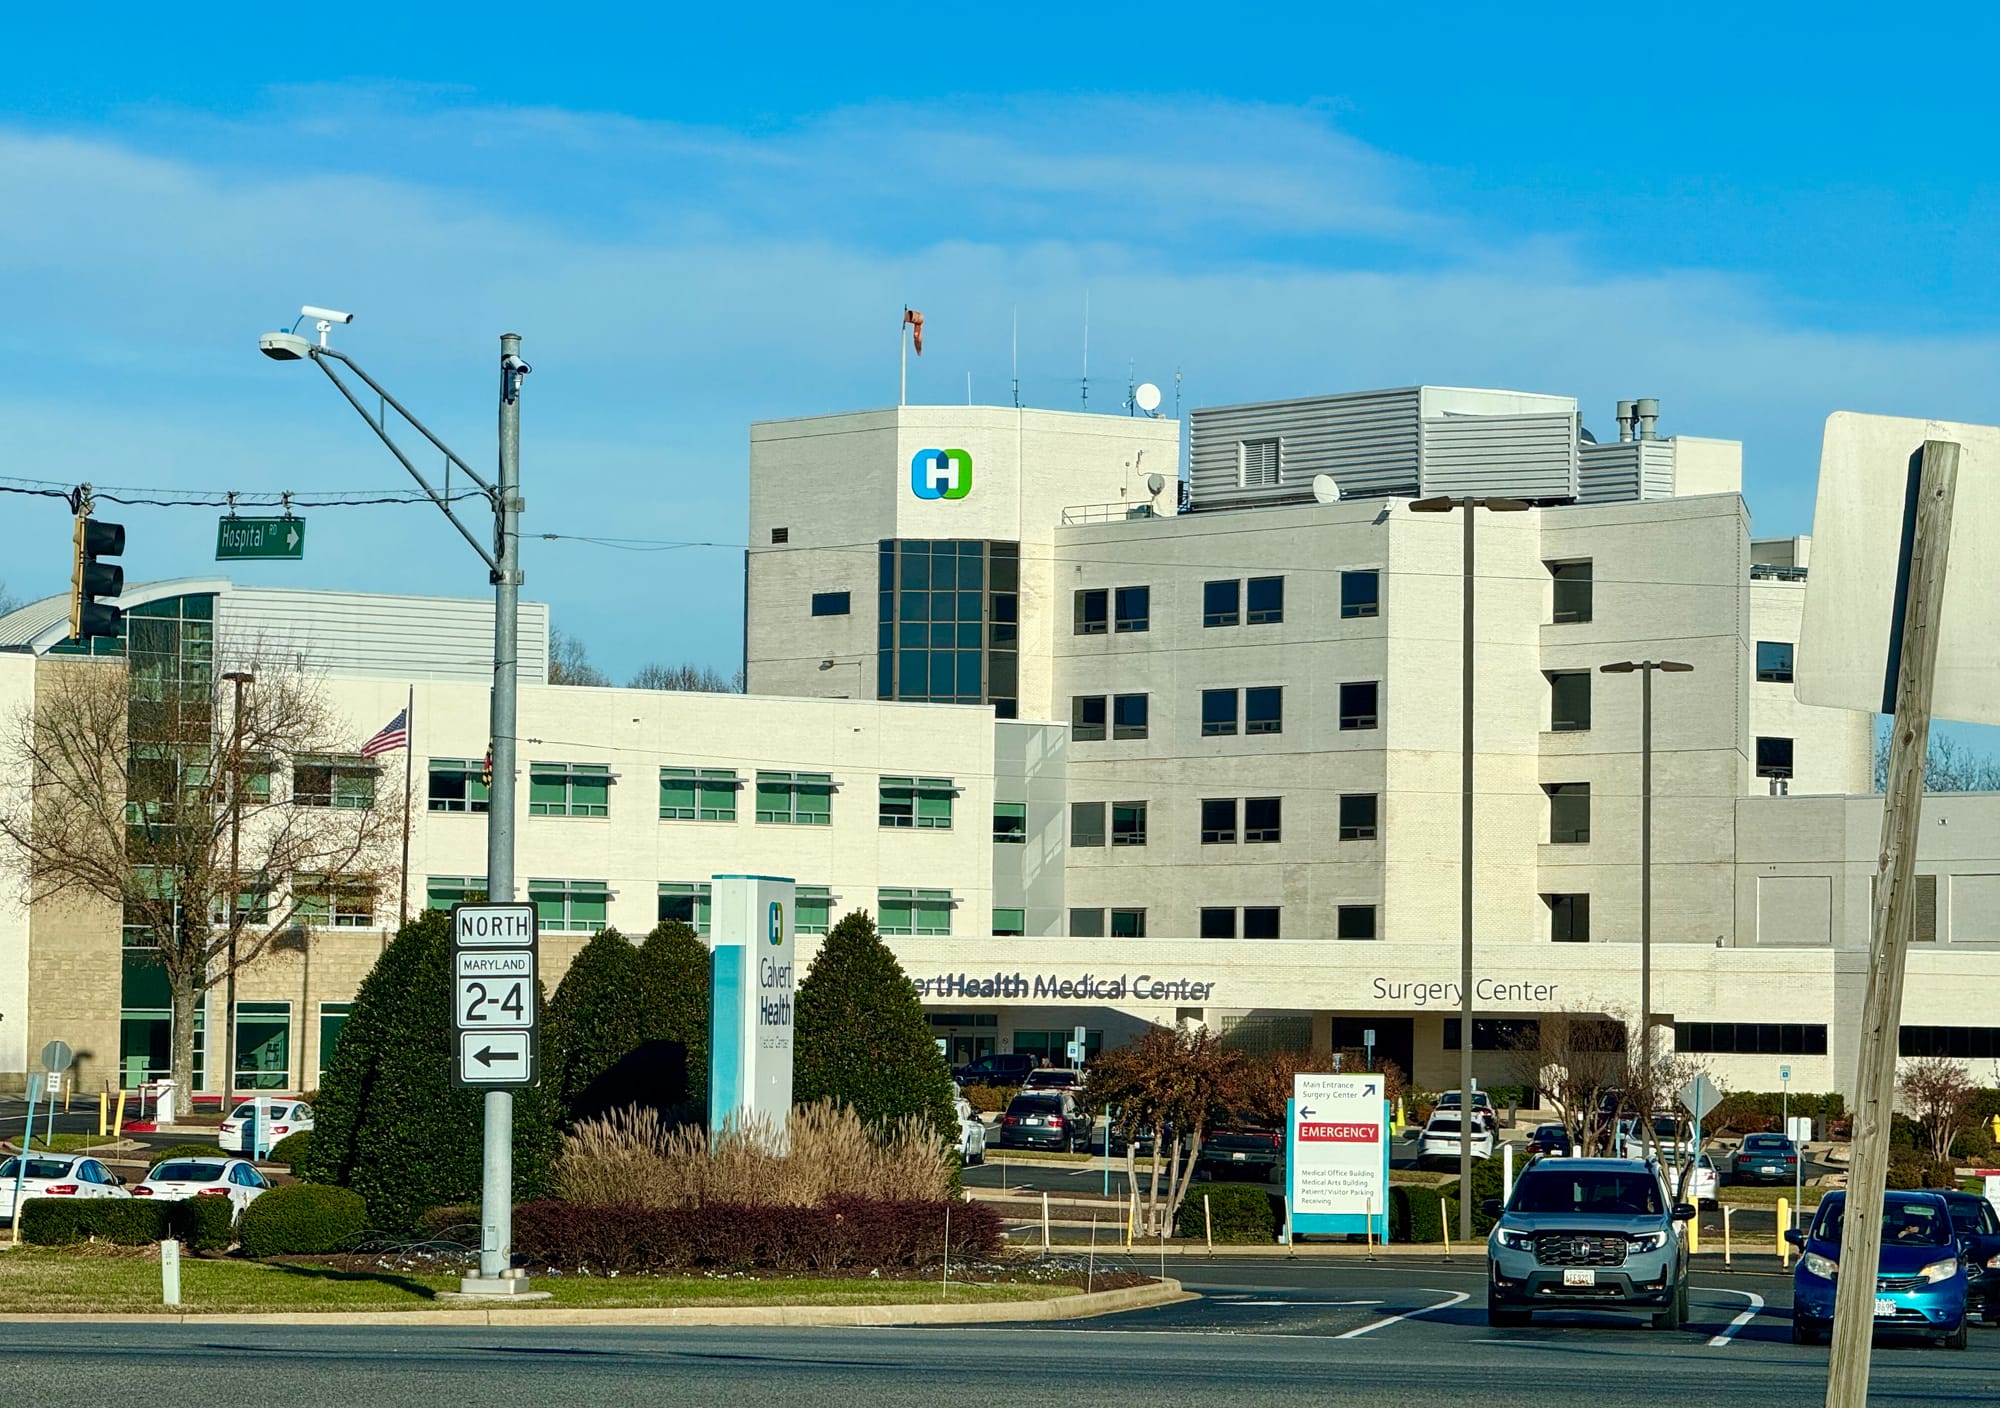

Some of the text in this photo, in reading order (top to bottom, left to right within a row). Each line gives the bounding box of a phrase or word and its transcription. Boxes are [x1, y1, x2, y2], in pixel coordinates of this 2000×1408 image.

[222, 524, 264, 552] Hospital
[462, 916, 528, 937] NORTH
[463, 959, 526, 970] MARYLAND
[760, 956, 792, 989] Calvert
[911, 972, 1216, 1000] ertHealth Medical Center
[1373, 977, 1559, 1006] Surgery Center
[466, 982, 524, 1021] 2-4
[760, 994, 791, 1026] Health
[1322, 1081, 1354, 1089] Entrance
[1303, 1091, 1331, 1100] Surgery
[1301, 1126, 1376, 1138] EMERGENCY
[1349, 1170, 1375, 1178] Building
[1343, 1179, 1368, 1188] Building
[1350, 1189, 1374, 1197] Parking
[1301, 1197, 1332, 1205] Receiving
